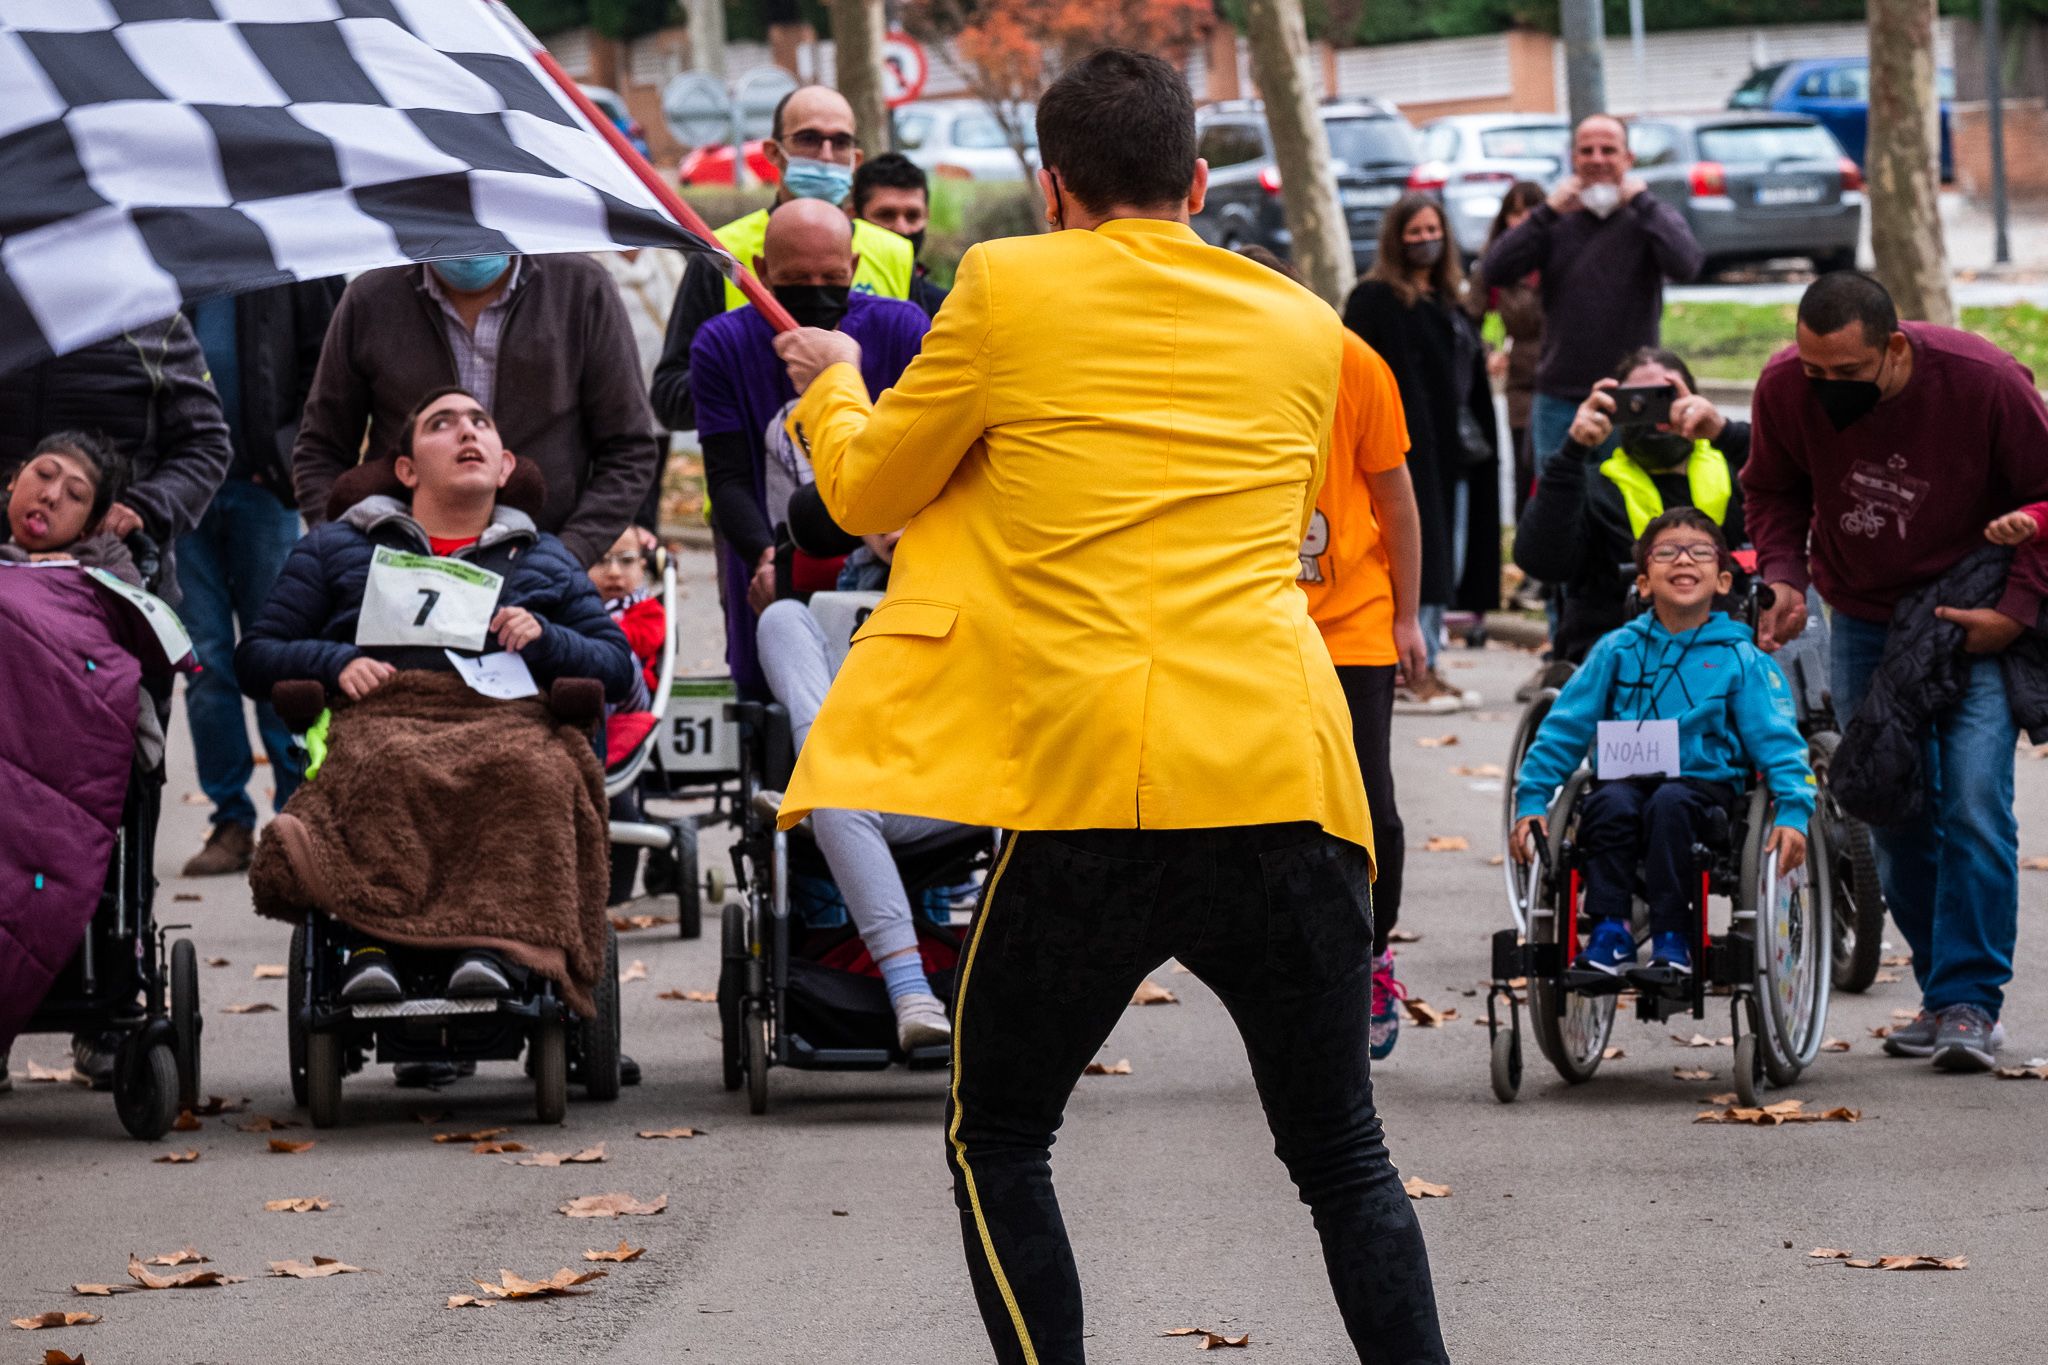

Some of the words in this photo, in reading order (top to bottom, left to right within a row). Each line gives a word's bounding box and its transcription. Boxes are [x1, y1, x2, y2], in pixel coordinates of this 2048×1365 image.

[413, 588, 441, 627] 7
[673, 716, 713, 756] 51
[1603, 740, 1661, 764] NOAH
